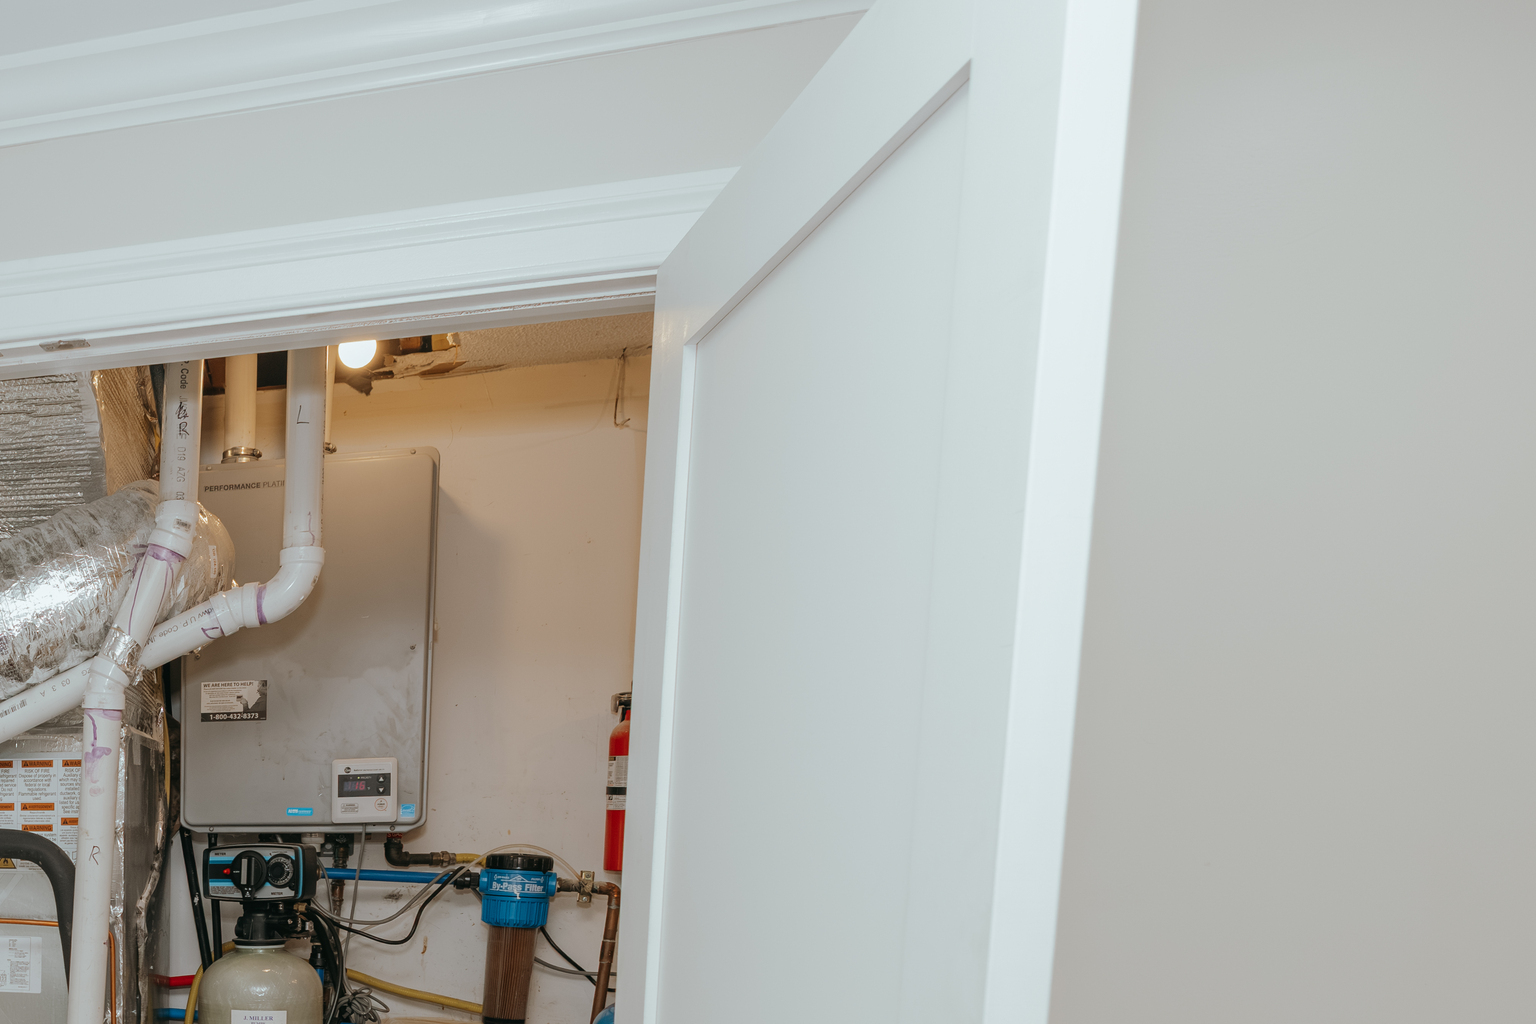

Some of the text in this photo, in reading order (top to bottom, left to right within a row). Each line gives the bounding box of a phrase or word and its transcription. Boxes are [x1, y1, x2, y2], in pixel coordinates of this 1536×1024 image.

[180, 368, 189, 389] Code
[204, 482, 260, 492] PERFORMANCE
[159, 625, 179, 638] Code
[89, 846, 100, 865] R
[492, 882, 544, 892] By-Pass Filter
